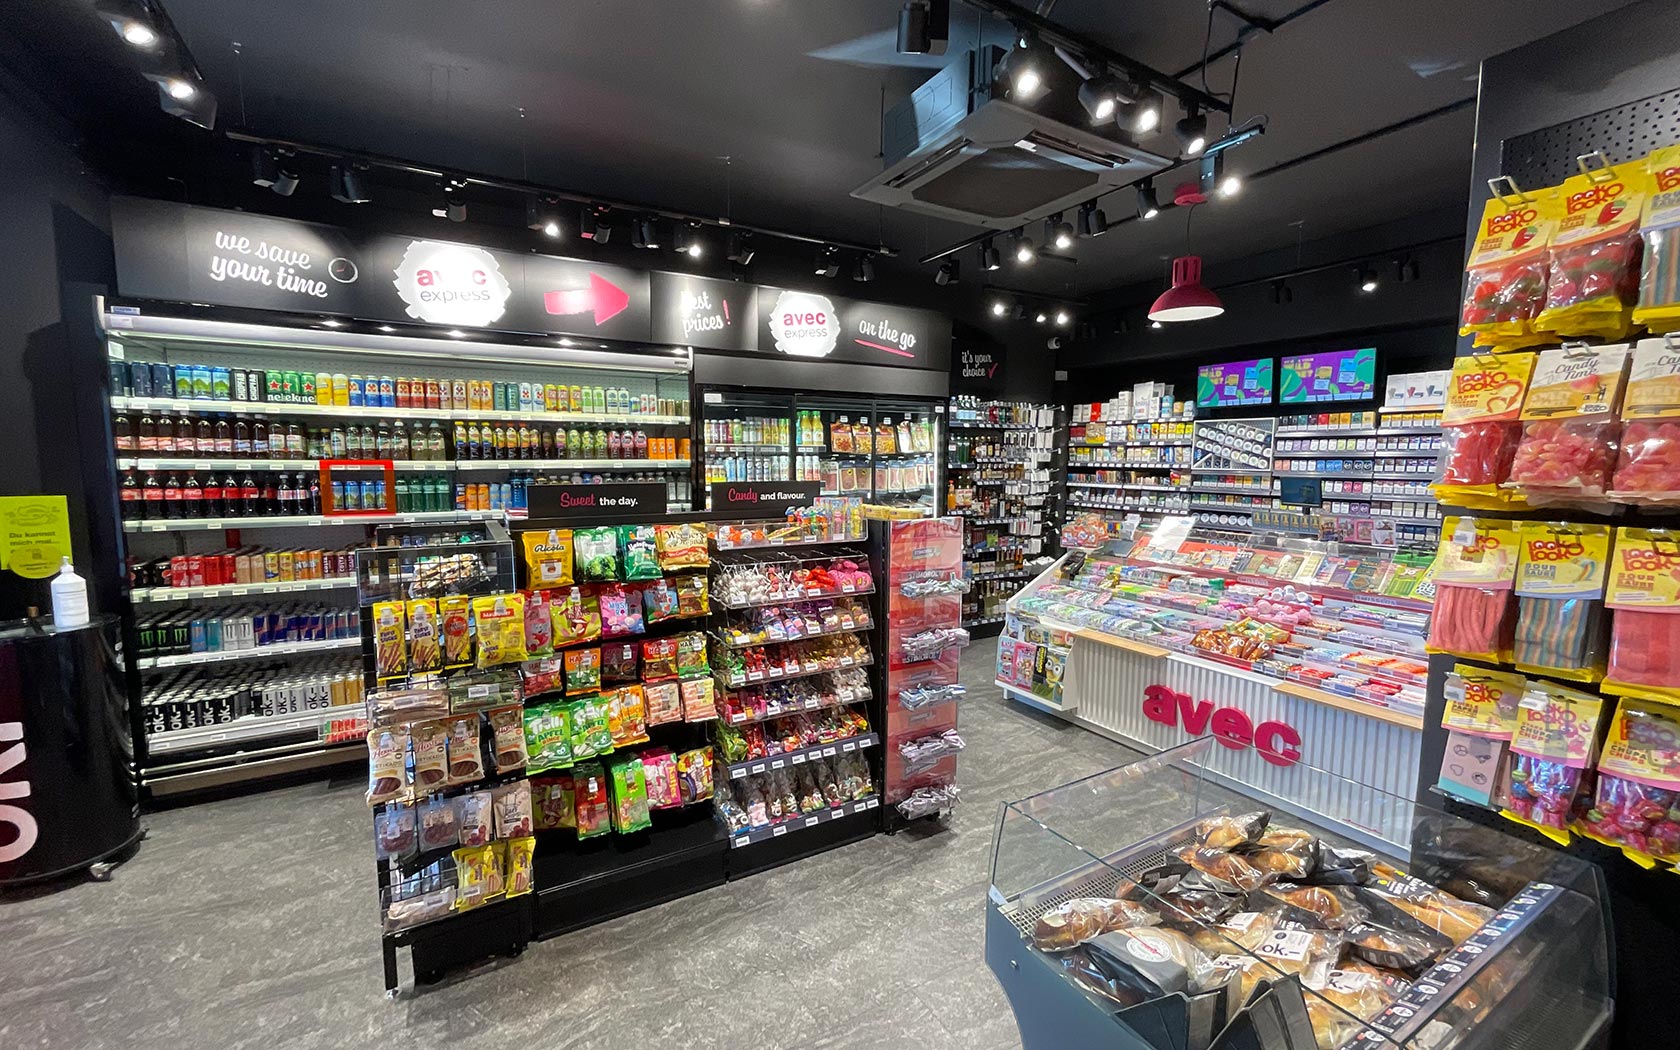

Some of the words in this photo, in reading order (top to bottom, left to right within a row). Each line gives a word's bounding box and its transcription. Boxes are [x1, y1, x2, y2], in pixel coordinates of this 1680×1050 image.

[215, 231, 251, 254] we
[254, 242, 312, 270] save
[210, 256, 273, 286] your
[276, 266, 328, 298] time
[416, 269, 487, 287] avc
[420, 290, 490, 304] express
[680, 291, 712, 310] est
[783, 312, 826, 326] avec
[784, 328, 828, 340] express
[859, 320, 877, 336] on
[878, 320, 899, 343] the
[899, 332, 917, 351] go
[961, 349, 974, 364] it's
[974, 354, 993, 369] your
[1555, 358, 1599, 374] Candy
[962, 363, 986, 378] choice
[560, 492, 597, 508] Sweet
[599, 497, 616, 506] the
[618, 496, 638, 507] day.
[728, 488, 758, 503] Candy
[760, 492, 775, 500] and
[777, 491, 806, 500] flavour.
[535, 544, 565, 553] Ricola
[1142, 684, 1303, 767] avec
